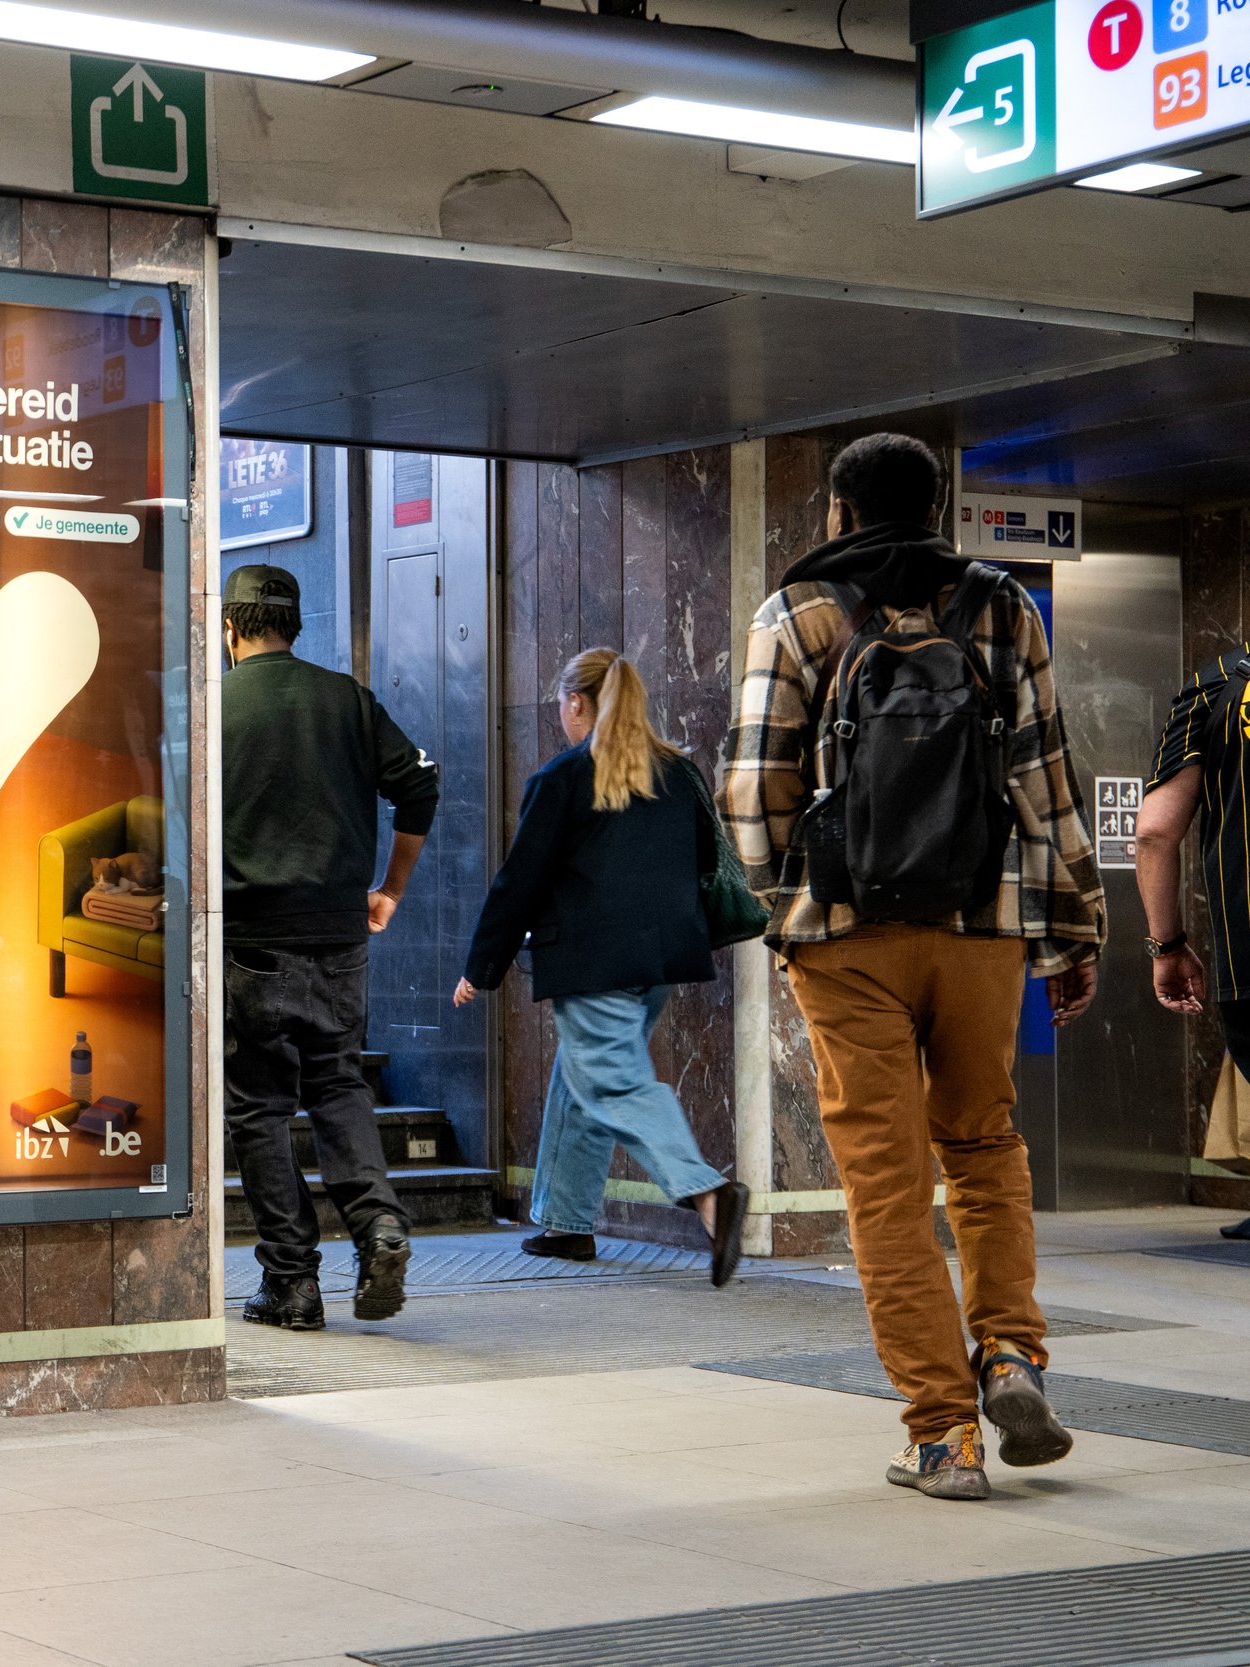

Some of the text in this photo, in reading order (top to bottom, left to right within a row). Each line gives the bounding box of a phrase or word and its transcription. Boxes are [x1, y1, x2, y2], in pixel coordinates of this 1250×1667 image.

[1102, 13, 1128, 55] T
[994, 85, 1014, 126] 5
[1158, 68, 1201, 114] 93
[268, 449, 288, 481] 36
[36, 515, 129, 536] Je gemeente
[15, 1127, 53, 1160] ibz
[99, 1121, 142, 1158] .be
[418, 1143, 427, 1156] 14
